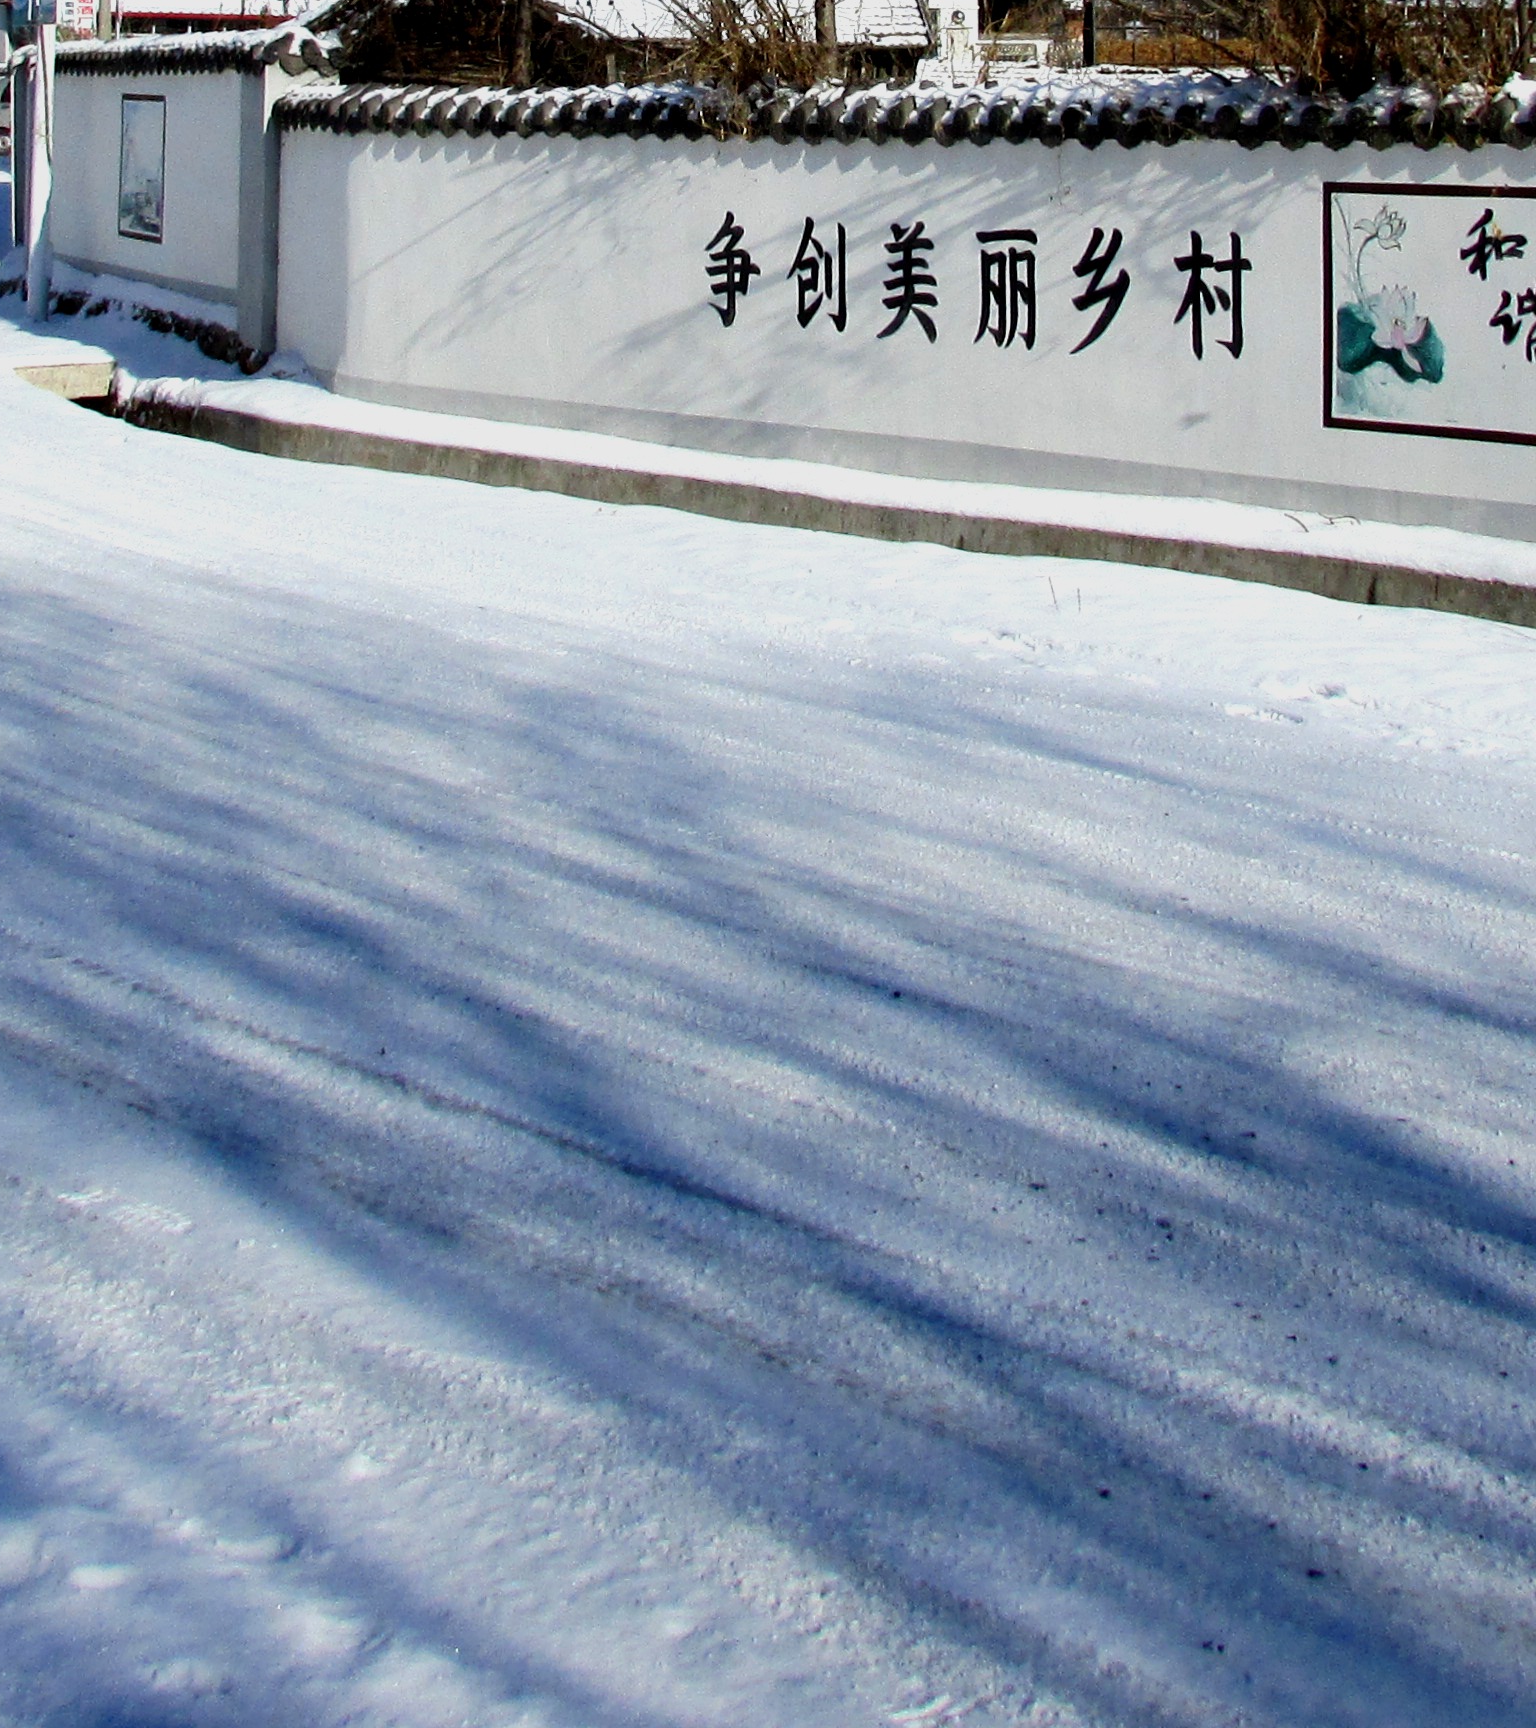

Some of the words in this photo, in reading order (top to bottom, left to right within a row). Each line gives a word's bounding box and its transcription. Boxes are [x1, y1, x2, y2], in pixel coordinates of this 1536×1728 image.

[704, 211, 1253, 361] 争创美丽乡村
